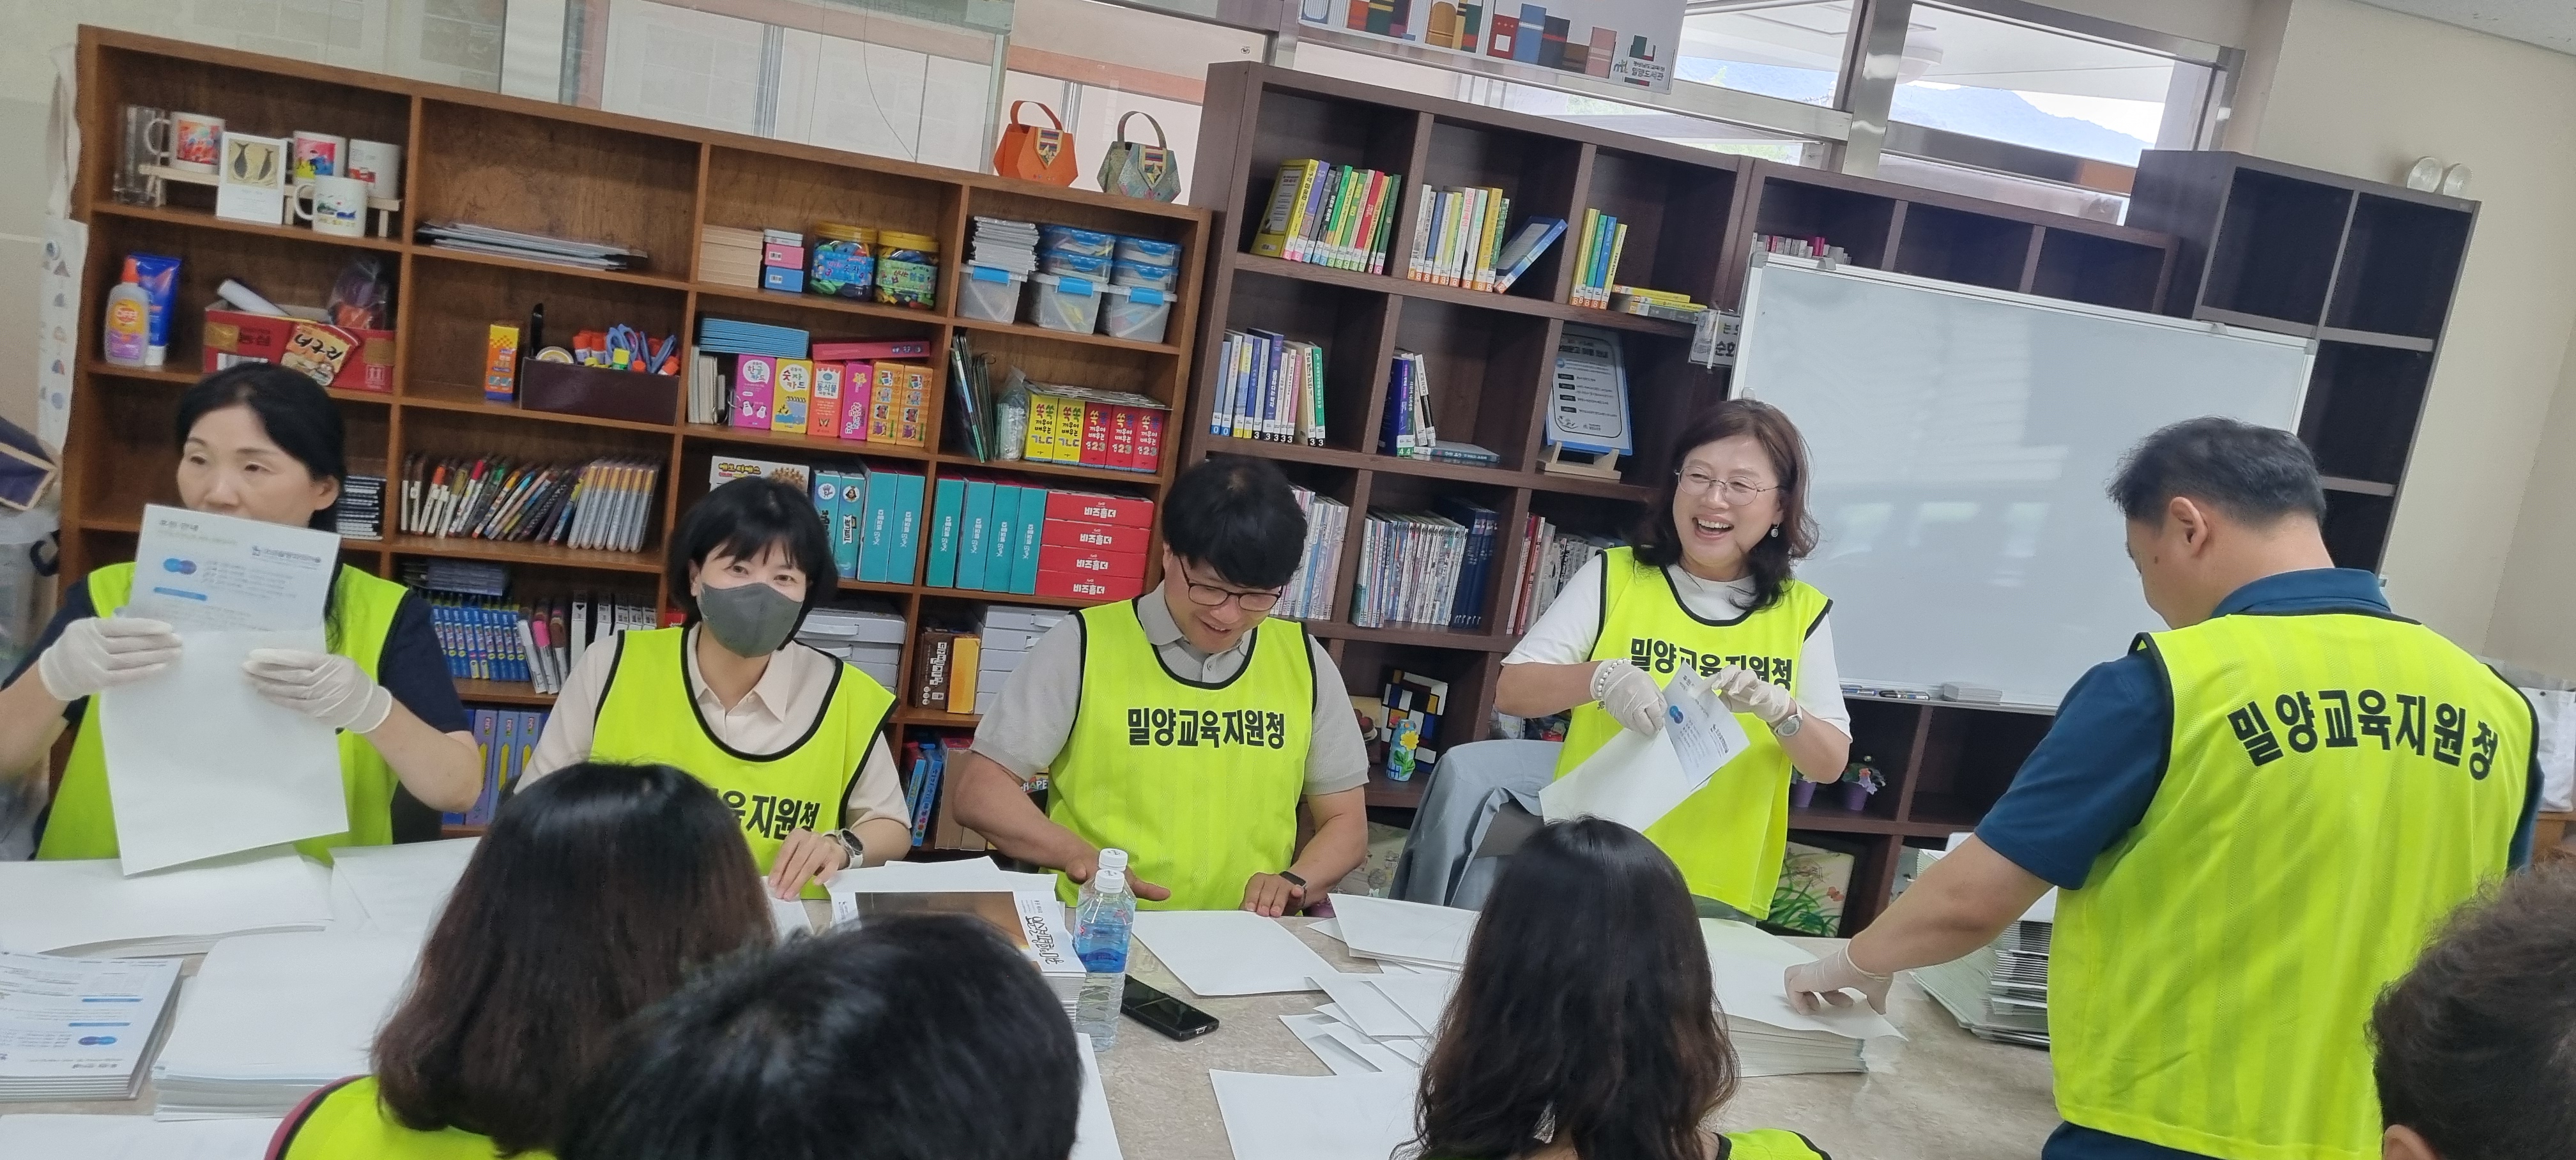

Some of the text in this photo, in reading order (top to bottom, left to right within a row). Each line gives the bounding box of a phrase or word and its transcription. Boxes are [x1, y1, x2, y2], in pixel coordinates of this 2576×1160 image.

[1329, 257, 1334, 266] 9
[1337, 259, 1342, 268] 9
[1344, 260, 1349, 268] 9
[1368, 263, 1373, 272] 8
[1375, 266, 1381, 274] 6
[1424, 273, 1429, 282] 8
[1433, 275, 1438, 283] 8
[1452, 278, 1458, 286] 8
[1486, 283, 1492, 291] 8
[1584, 298, 1590, 307] 8
[294, 333, 343, 361] 너구리
[747, 365, 763, 375] 한글
[783, 369, 802, 381] 숫자
[816, 383, 837, 393] 동식물
[1034, 426, 1052, 434] 배우는
[1088, 432, 1105, 441] 배우는
[1128, 707, 1285, 750] 밀양교육지원청
[2227, 689, 2499, 781] 밀양교육지원청
[1023, 777, 1048, 792] HAPE
[708, 788, 821, 841] 육지원청
